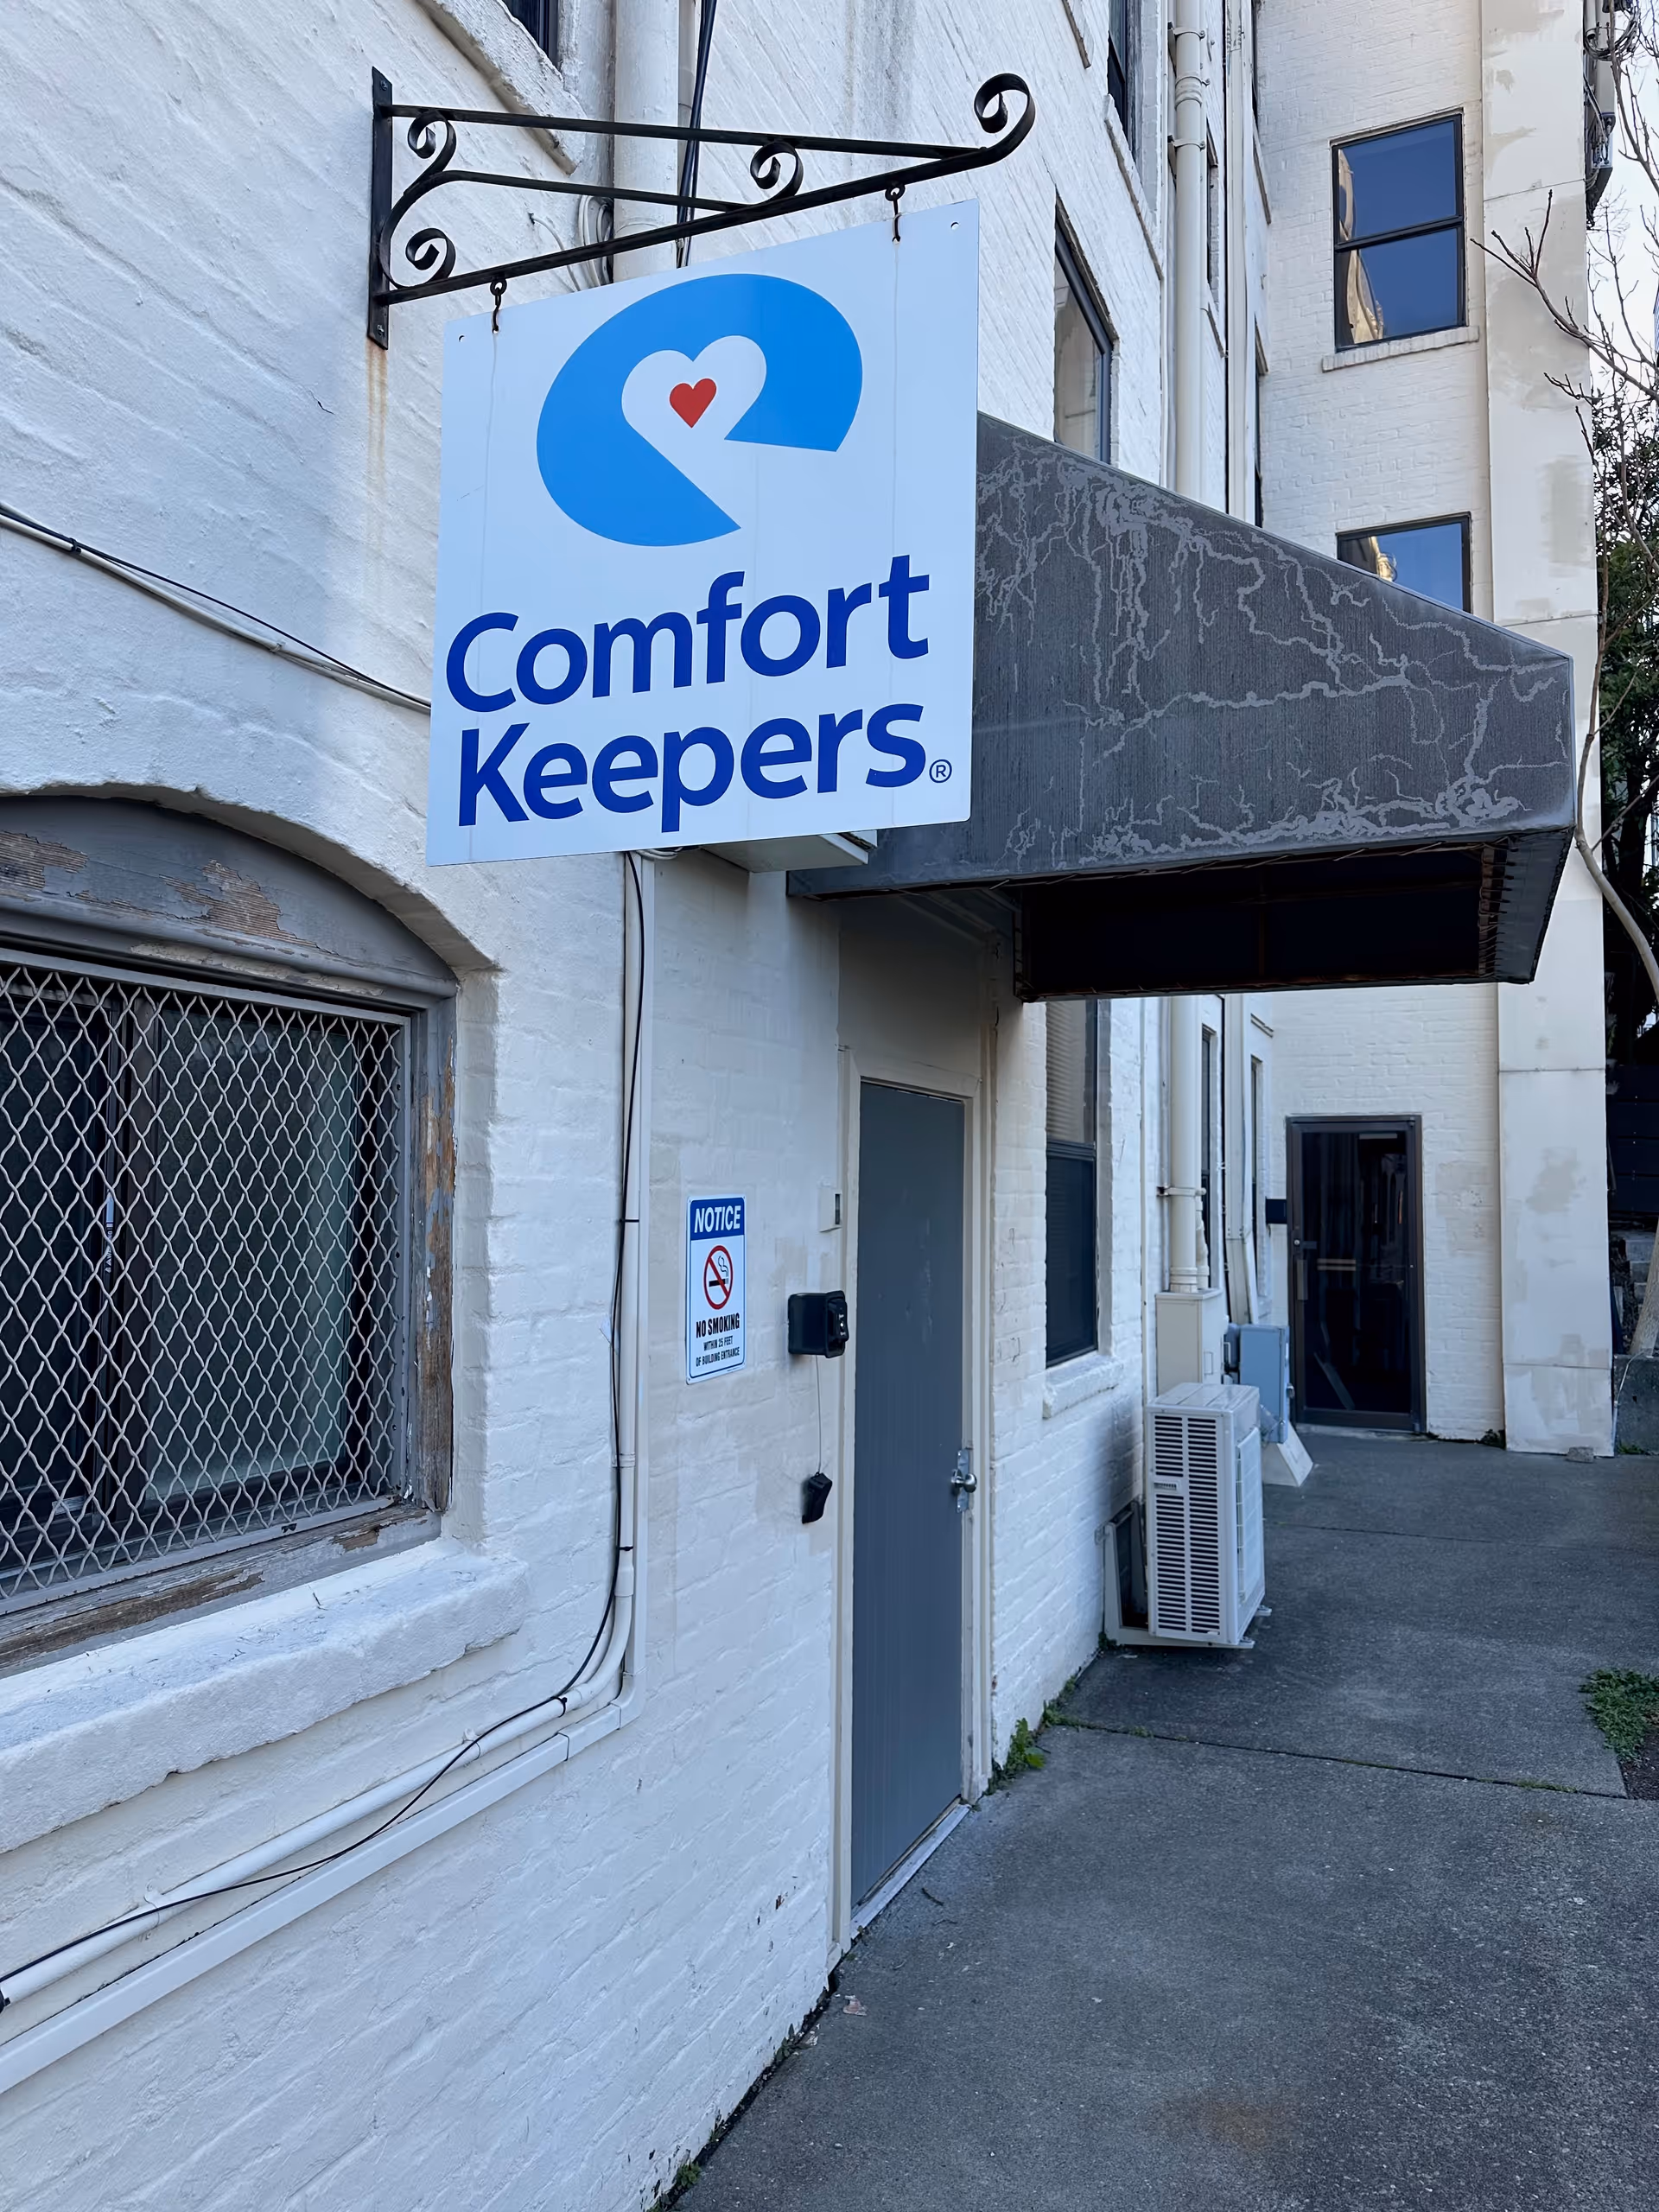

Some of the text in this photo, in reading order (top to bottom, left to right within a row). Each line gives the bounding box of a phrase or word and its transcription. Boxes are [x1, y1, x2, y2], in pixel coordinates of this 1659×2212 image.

[446, 554, 930, 712] Comfort
[694, 1205, 741, 1233] NOTICE
[696, 1313, 740, 1338] NO SMOKING
[703, 1335, 734, 1351] WITHIN 25 FEET
[696, 1346, 740, 1367] OF BUILDING ENTRANCE
